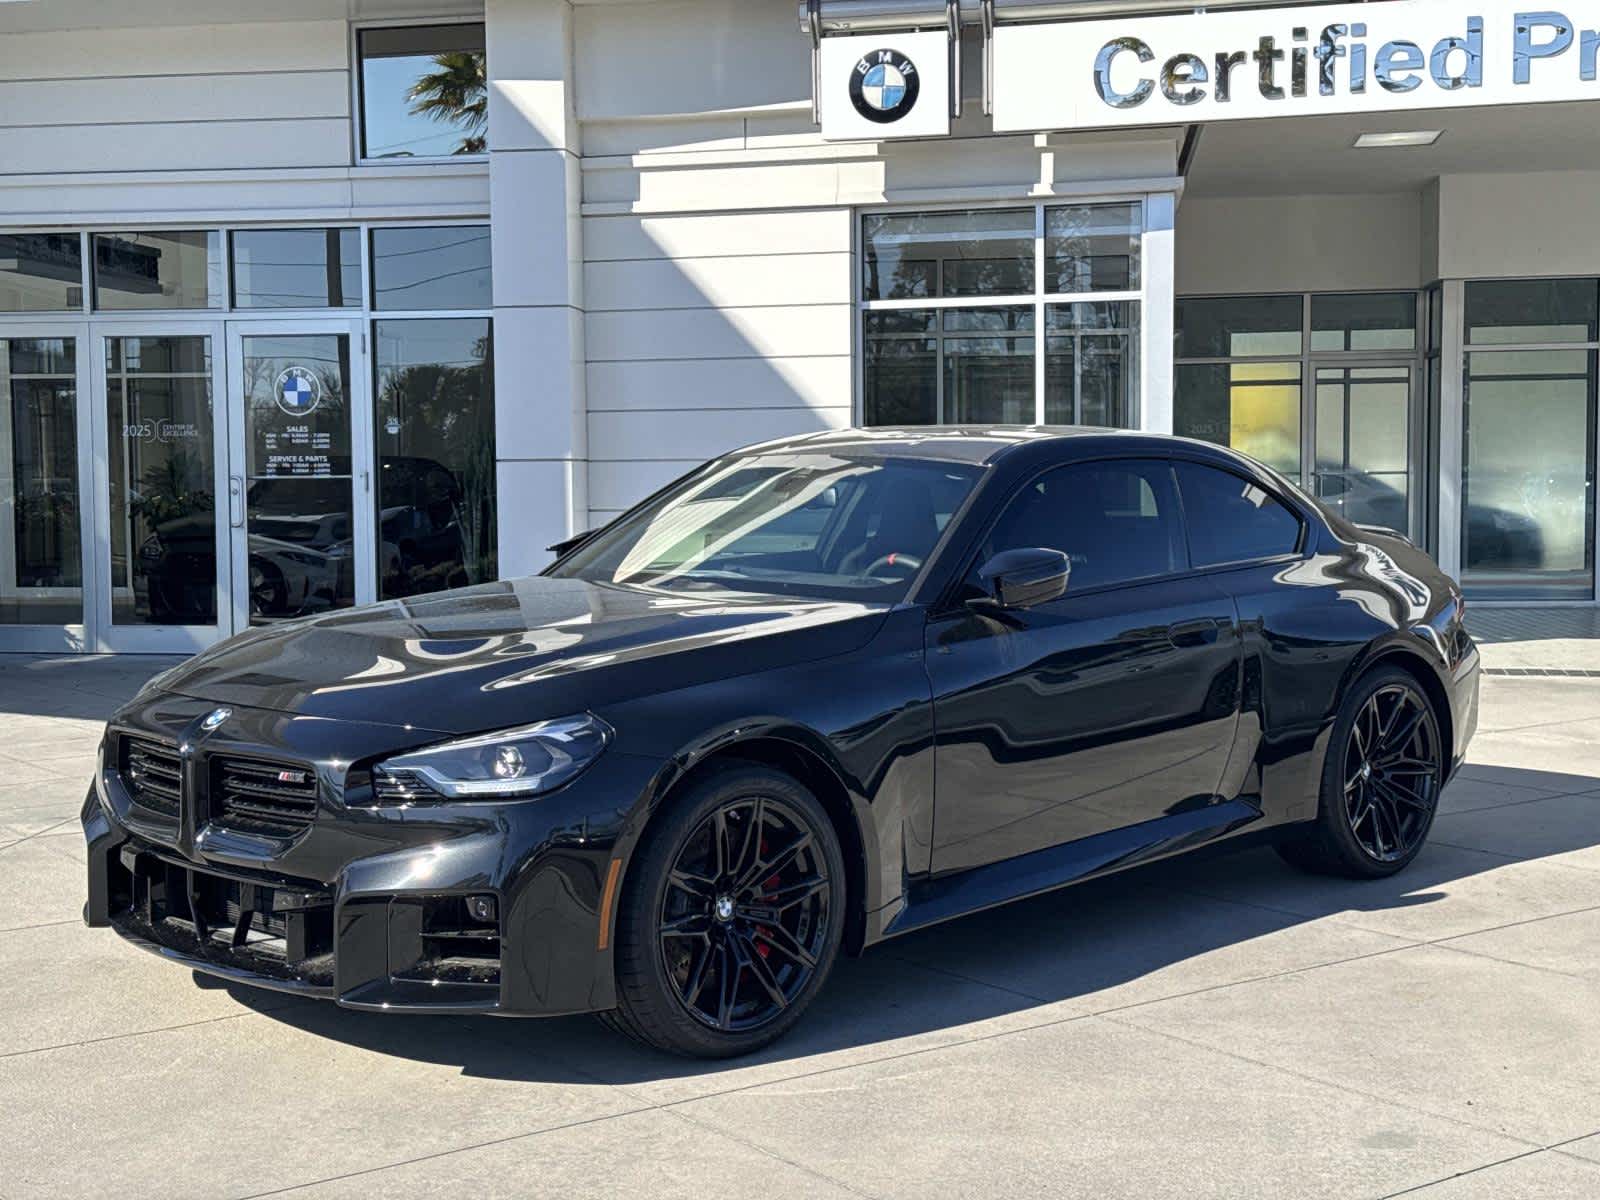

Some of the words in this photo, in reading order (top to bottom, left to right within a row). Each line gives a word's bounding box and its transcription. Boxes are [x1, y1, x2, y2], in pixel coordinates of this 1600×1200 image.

[856, 51, 915, 75] BMW
[1094, 15, 1483, 109] Certified
[280, 369, 314, 384] BMW
[122, 424, 152, 437] 2025
